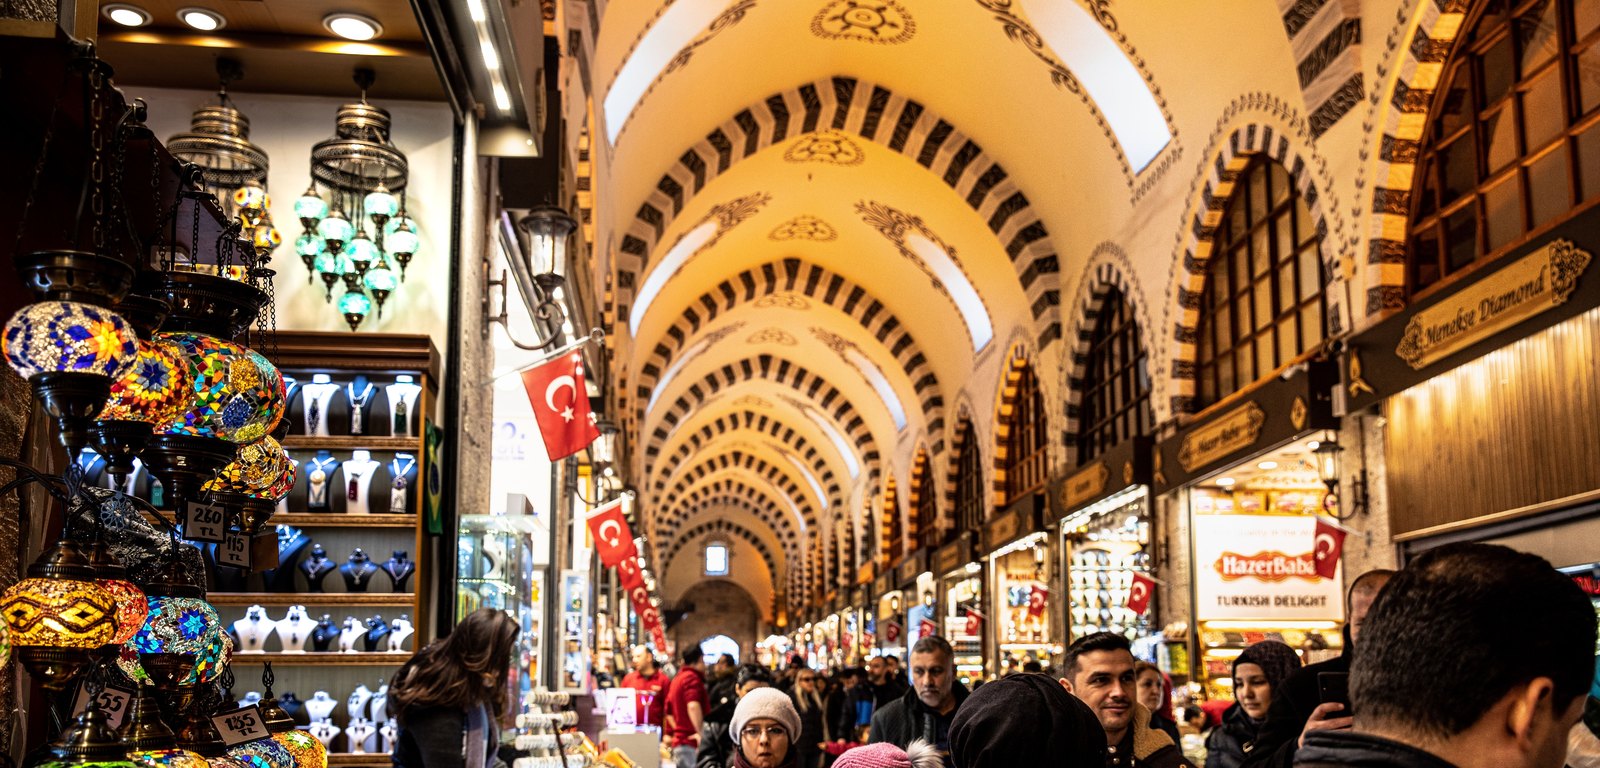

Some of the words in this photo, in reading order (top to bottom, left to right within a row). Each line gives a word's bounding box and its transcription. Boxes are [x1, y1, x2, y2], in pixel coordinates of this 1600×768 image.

[1478, 264, 1548, 322] Diamond
[193, 507, 221, 524] 260
[200, 527, 218, 536] TL
[227, 536, 244, 552] 115
[228, 553, 243, 561] TL
[1217, 595, 1270, 607] TURKISH
[1274, 595, 1327, 607] DELIGHT
[238, 728, 259, 736] TL
